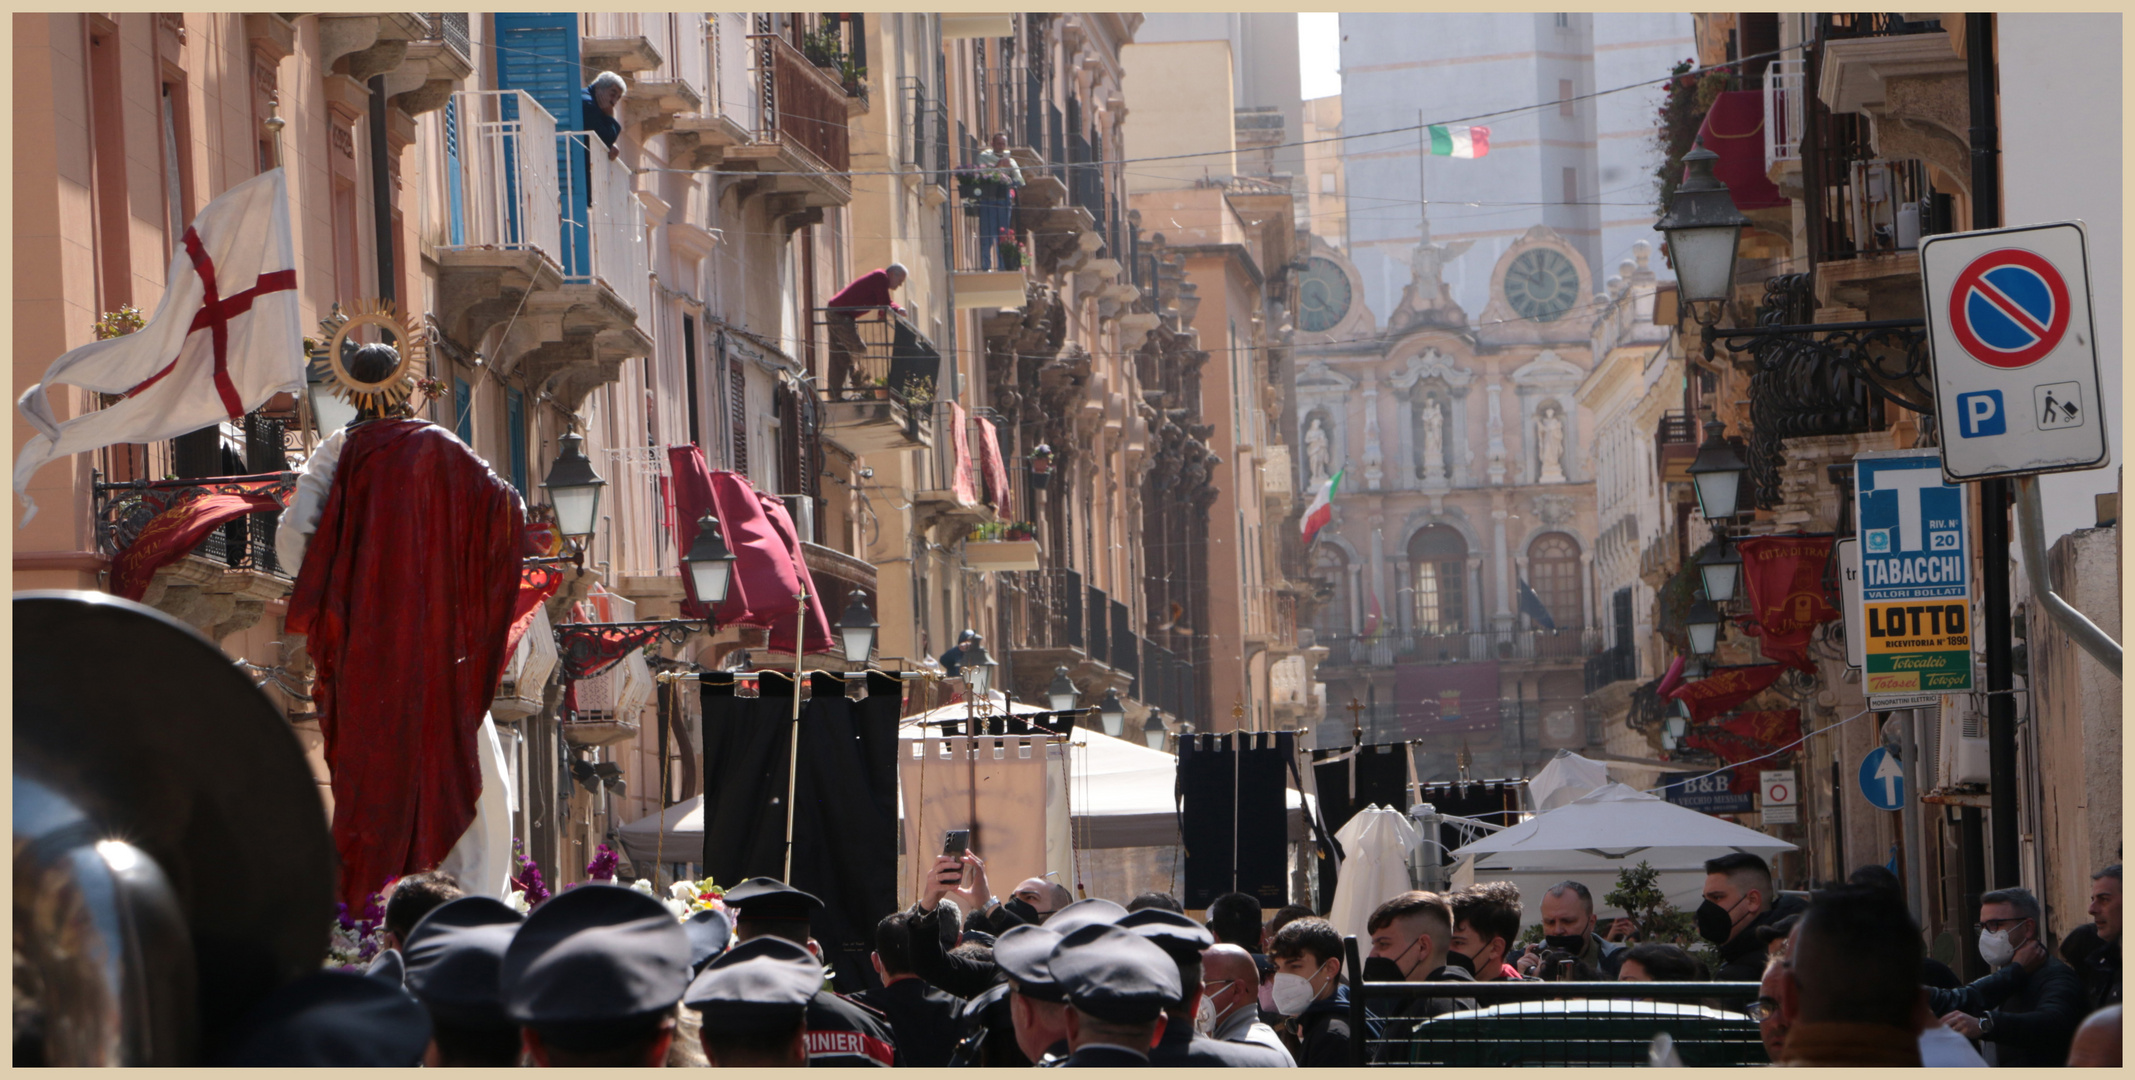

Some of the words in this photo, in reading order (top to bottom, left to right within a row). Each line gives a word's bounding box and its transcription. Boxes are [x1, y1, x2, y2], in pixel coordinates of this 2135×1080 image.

[1967, 394, 1996, 434] P
[1873, 468, 1943, 552] T
[1930, 520, 1947, 529] RIV.
[1935, 534, 1955, 547] 20
[1790, 547, 1801, 557] DI
[1865, 556, 1961, 586] TABACCHI
[1868, 590, 1910, 599] VALORI
[1914, 587, 1962, 597] BOLLATI
[1869, 604, 1965, 638] LOTTO
[1885, 639, 1935, 648] RICEVITORIA
[1946, 636, 1968, 646] 1890
[1890, 654, 1947, 670] Totocalcio
[1870, 676, 1918, 690] Totosei
[1926, 672, 1966, 688] Totogol
[1872, 697, 1910, 707] MONOPATTINI
[1911, 695, 1937, 703] ELETTRICI
[1682, 774, 1729, 794] B&B
[1678, 796, 1712, 806] VECCHIO
[1713, 793, 1749, 804] MESSINA
